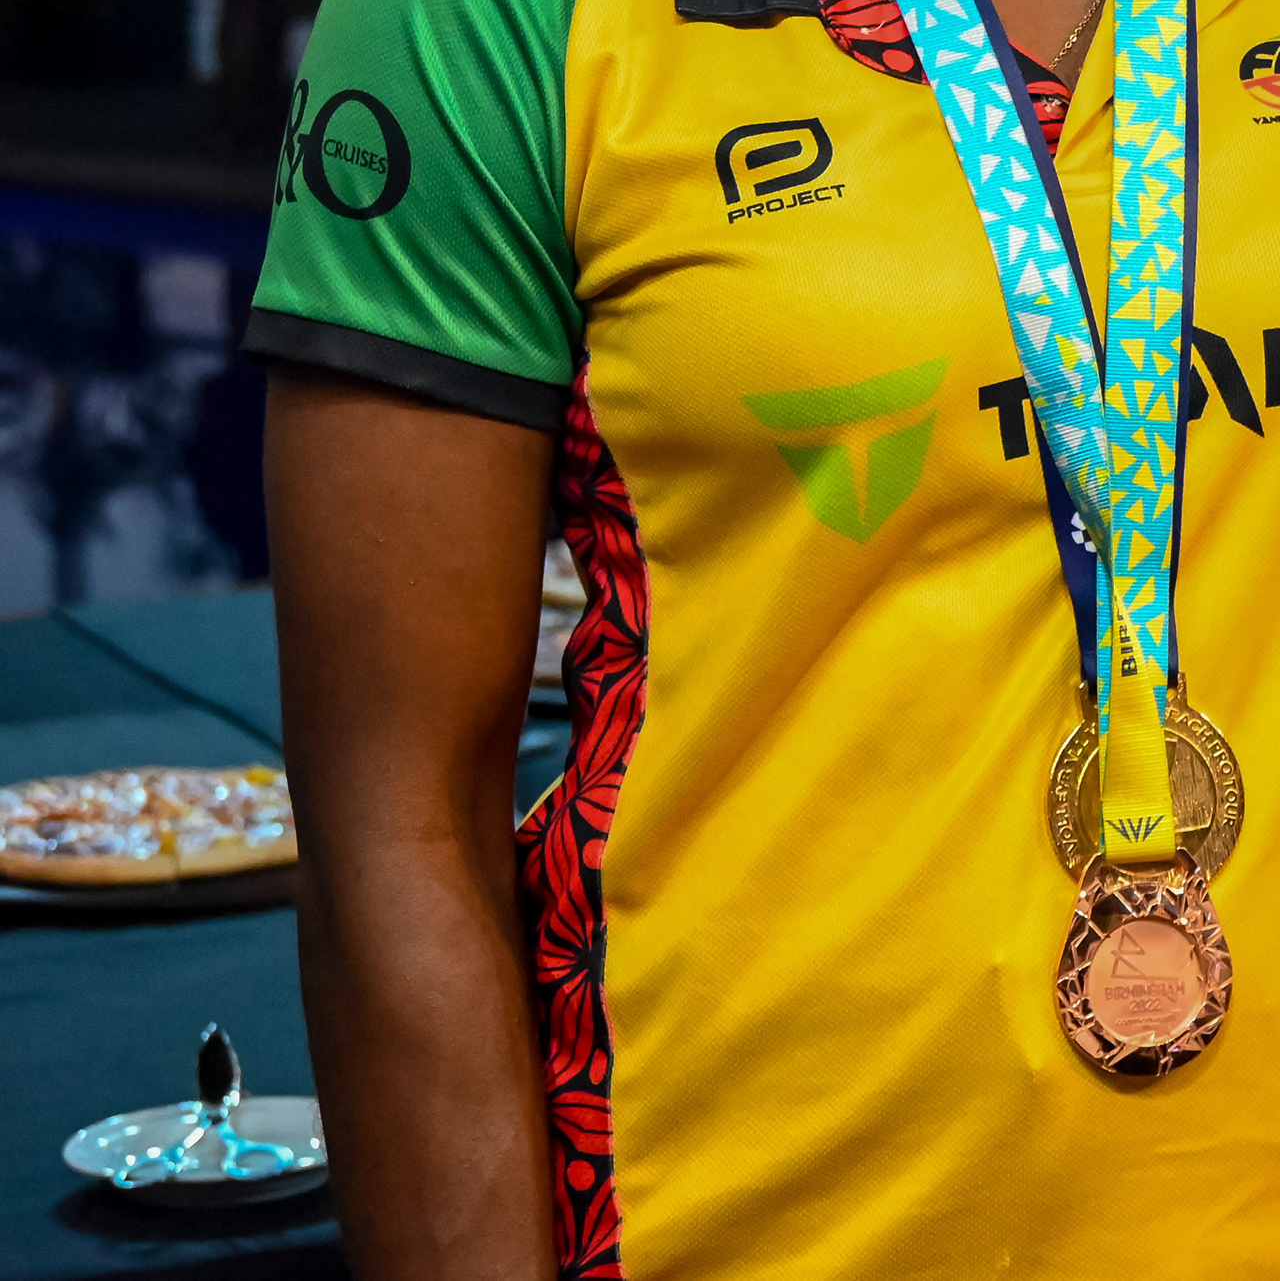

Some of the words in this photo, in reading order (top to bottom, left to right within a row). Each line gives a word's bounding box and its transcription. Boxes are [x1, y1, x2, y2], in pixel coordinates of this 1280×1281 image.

[323, 138, 389, 175] CRUISES
[727, 184, 846, 225] PROJECT
[1206, 739, 1234, 775] PRO
[1222, 776, 1240, 828] TOUR
